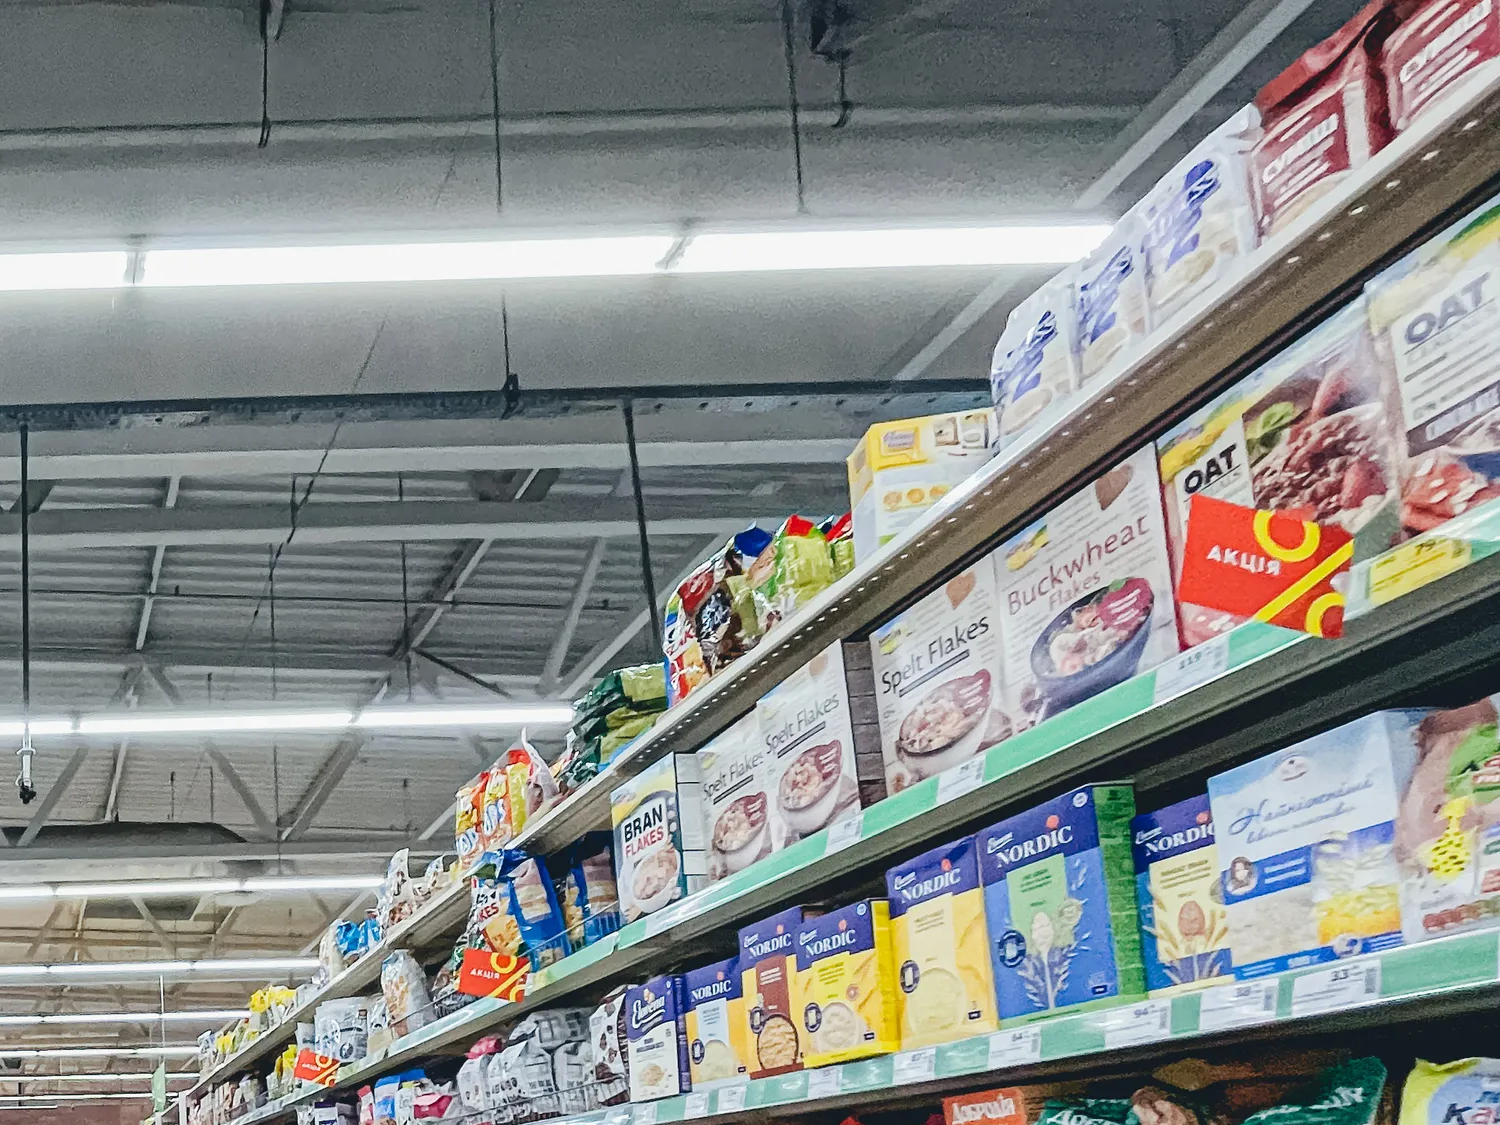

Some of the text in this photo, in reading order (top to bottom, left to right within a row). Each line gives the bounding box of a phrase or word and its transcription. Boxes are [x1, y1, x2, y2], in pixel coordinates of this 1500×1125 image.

[1404, 271, 1491, 345] OAT
[1183, 443, 1238, 494] OAT
[1008, 514, 1150, 615] Buckwheat
[1206, 544, 1283, 577] АКЦІЯ
[882, 615, 990, 695] Spelt Flakes
[765, 693, 840, 755] Spelt Flakes
[729, 752, 765, 784] Flakes
[623, 804, 664, 843] BRAN
[625, 826, 666, 858] FLAKES
[996, 825, 1074, 869] NORDIC
[901, 868, 961, 903] NORDIC
[749, 932, 792, 958] NORDIC
[804, 929, 856, 958] NORDIC
[470, 969, 500, 981] АКЦІЯ
[691, 979, 732, 1002] NORDIC
